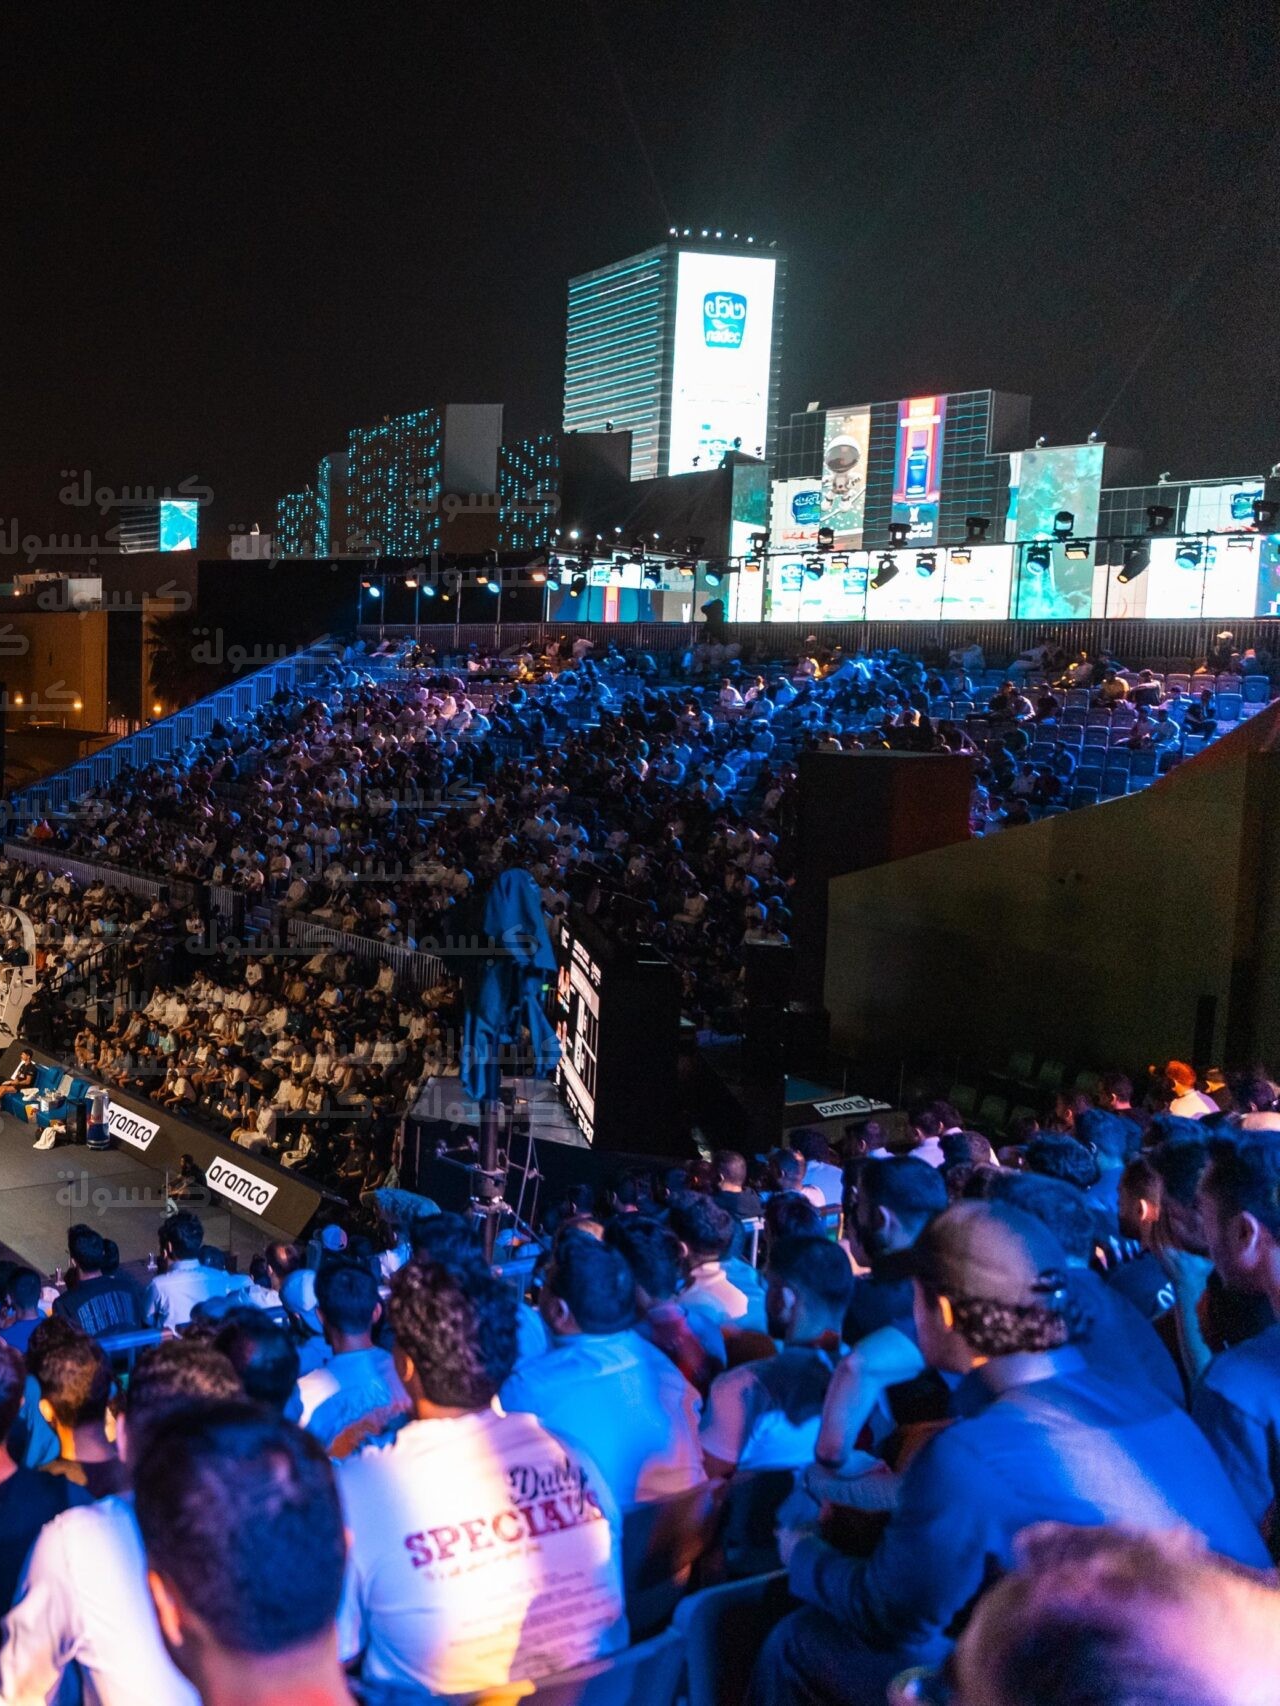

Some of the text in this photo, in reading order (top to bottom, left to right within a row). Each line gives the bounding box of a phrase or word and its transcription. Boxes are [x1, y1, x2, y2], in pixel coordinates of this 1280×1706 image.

[706, 330, 741, 344] nadec
[208, 1165, 269, 1206] aramco
[404, 1490, 604, 1568] SPECIALS
